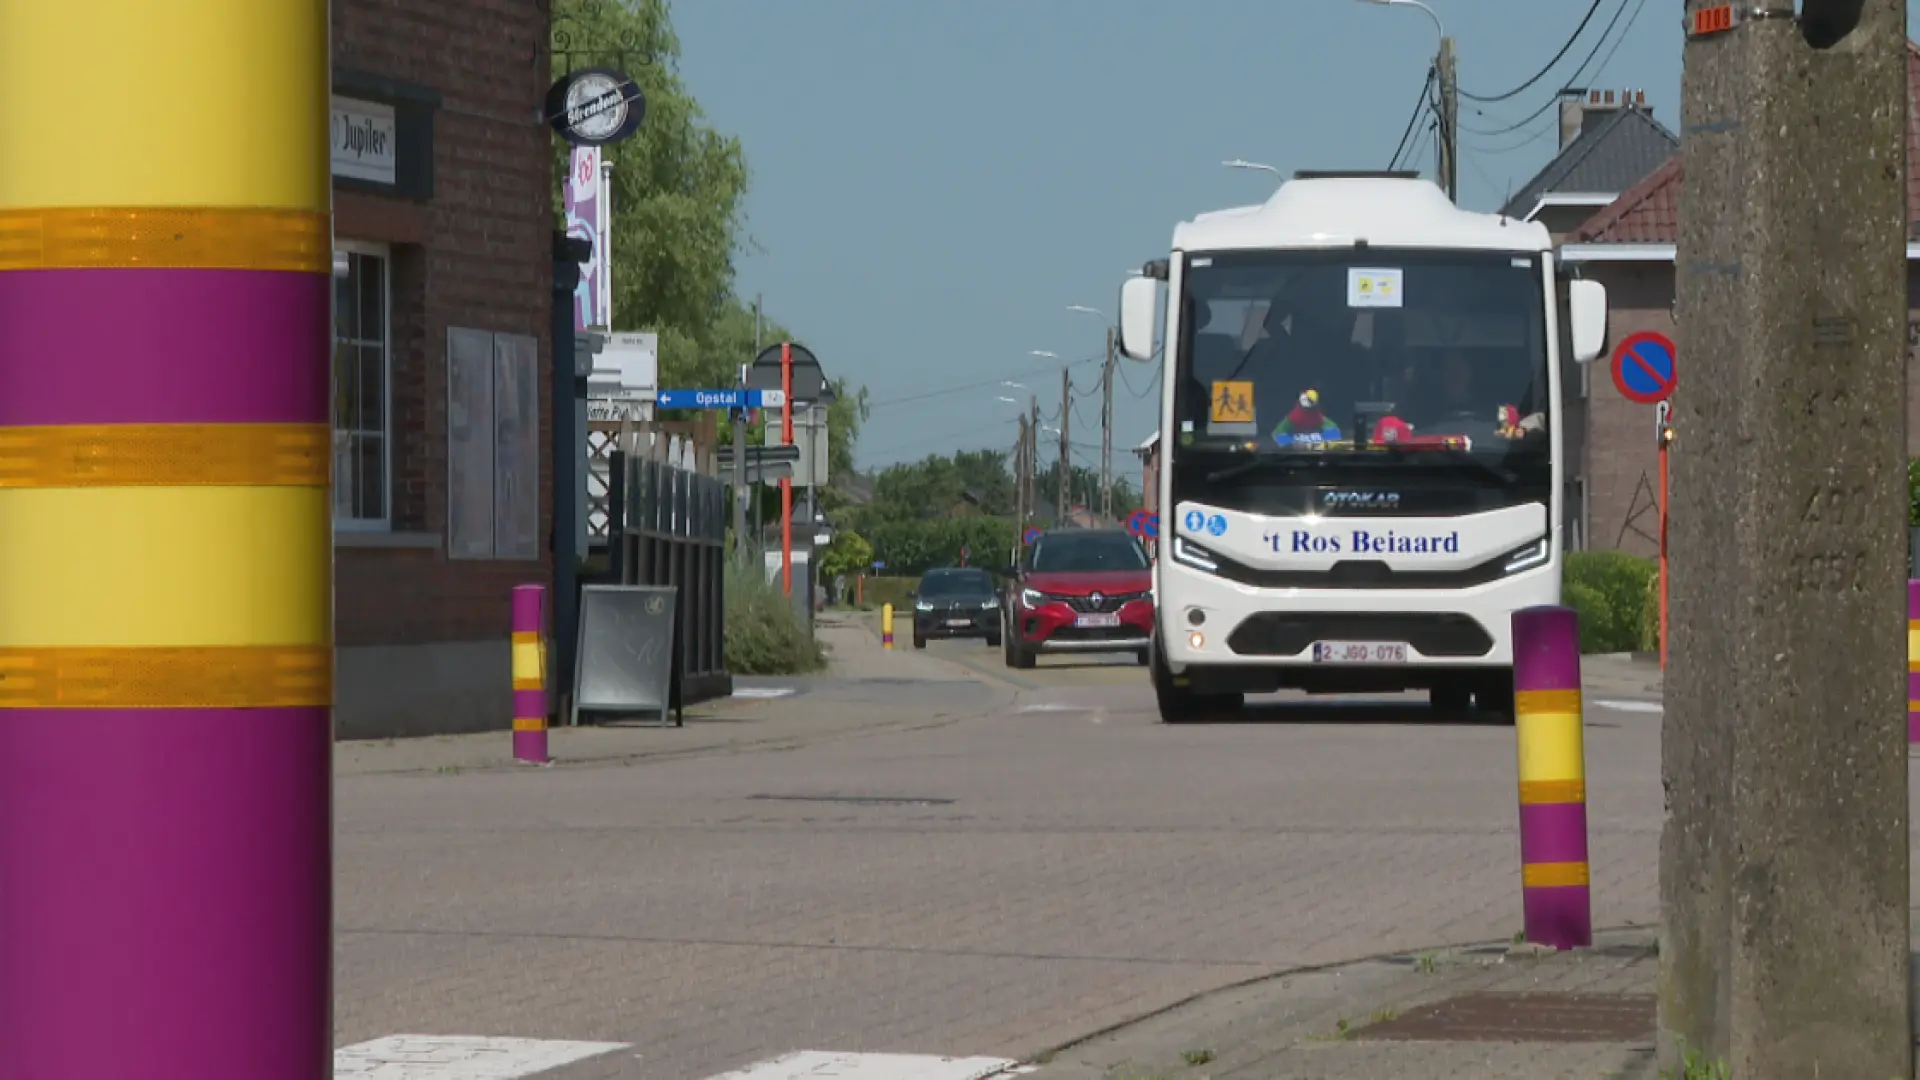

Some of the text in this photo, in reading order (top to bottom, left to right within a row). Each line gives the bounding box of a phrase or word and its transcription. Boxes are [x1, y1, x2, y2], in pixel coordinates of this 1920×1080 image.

[342, 113, 386, 160] Jupiler
[695, 391, 737, 408] Opstal
[1323, 491, 1400, 508] OTOKAR
[1291, 530, 1341, 553] Ros
[1352, 529, 1459, 553] Beiaard
